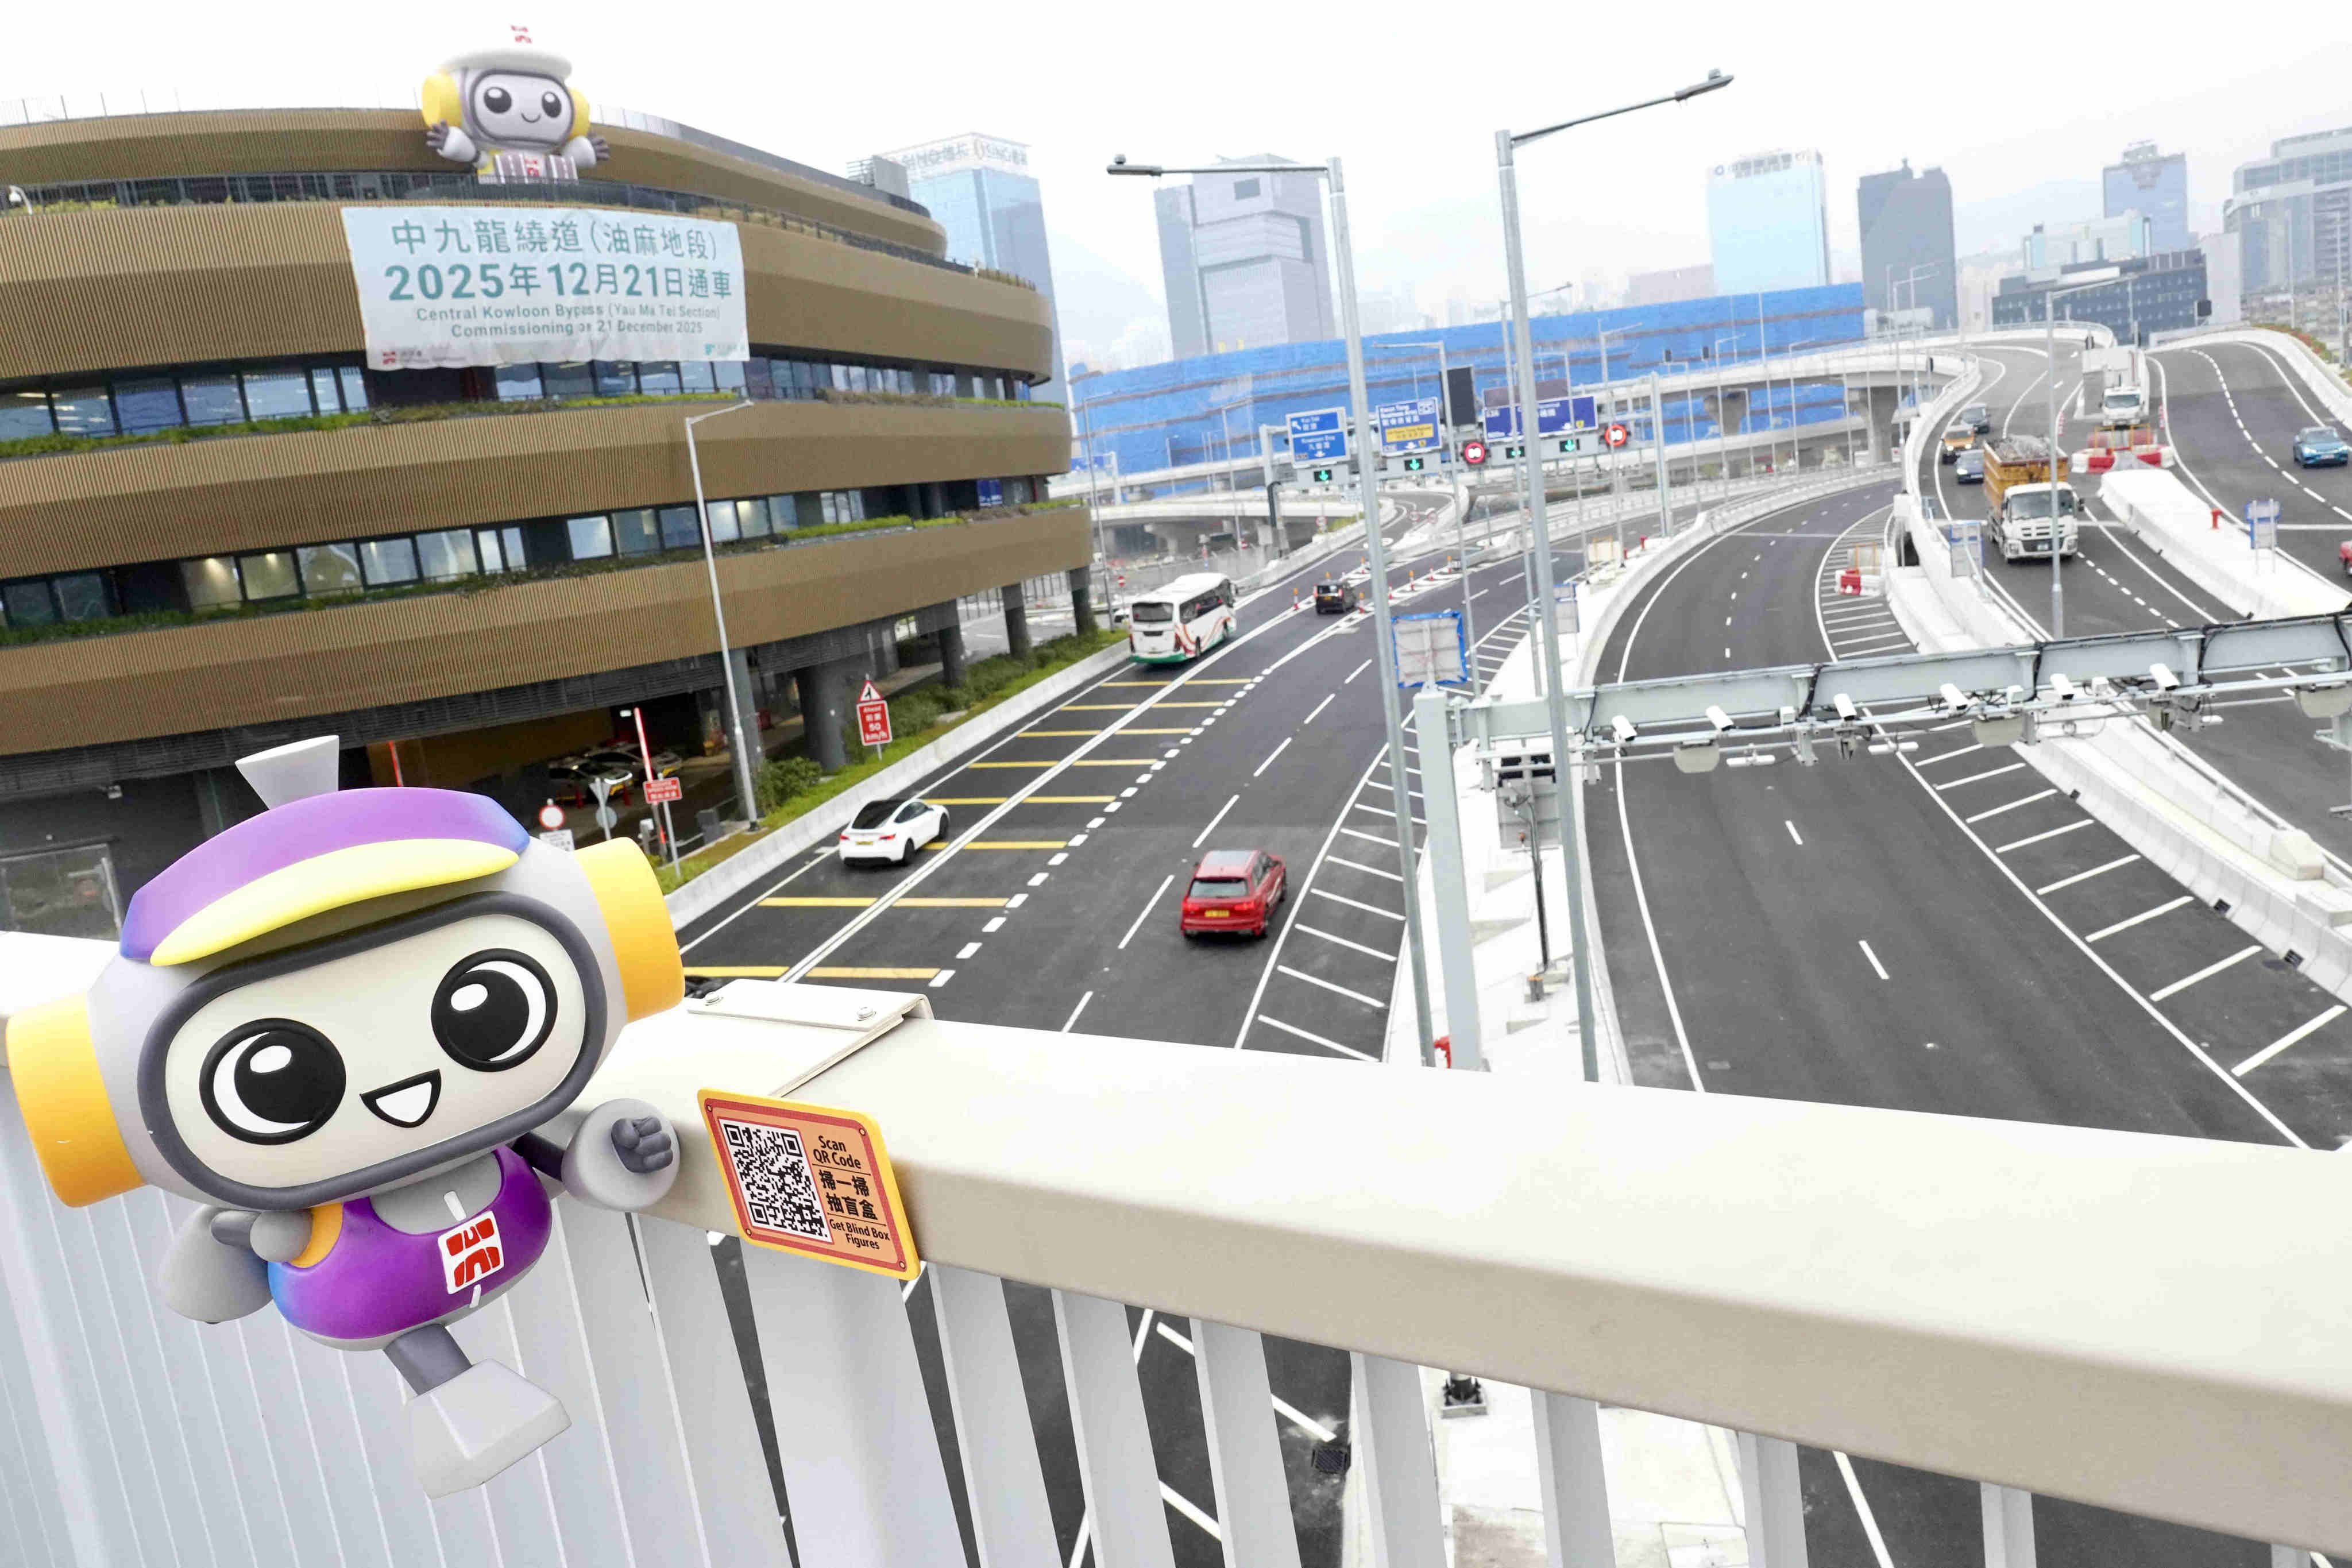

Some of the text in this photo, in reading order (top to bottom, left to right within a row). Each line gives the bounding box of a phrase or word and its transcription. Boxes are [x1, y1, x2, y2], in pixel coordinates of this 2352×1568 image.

[384, 262, 731, 301] 2025年12月21日通車
[416, 303, 721, 321] Central Kowloon Bypass (Yau Ma Tei Section)
[451, 320, 574, 338] Commissioning
[597, 320, 613, 333] 21
[617, 320, 674, 334] December
[677, 322, 703, 334] 2025
[818, 1135, 847, 1152] Scan
[813, 1149, 862, 1169] QR Code
[818, 1169, 870, 1196] 掃一掃
[825, 1192, 878, 1221] 抽盲盒
[829, 1219, 890, 1241] Get Blind Box
[845, 1233, 880, 1250] Figures
